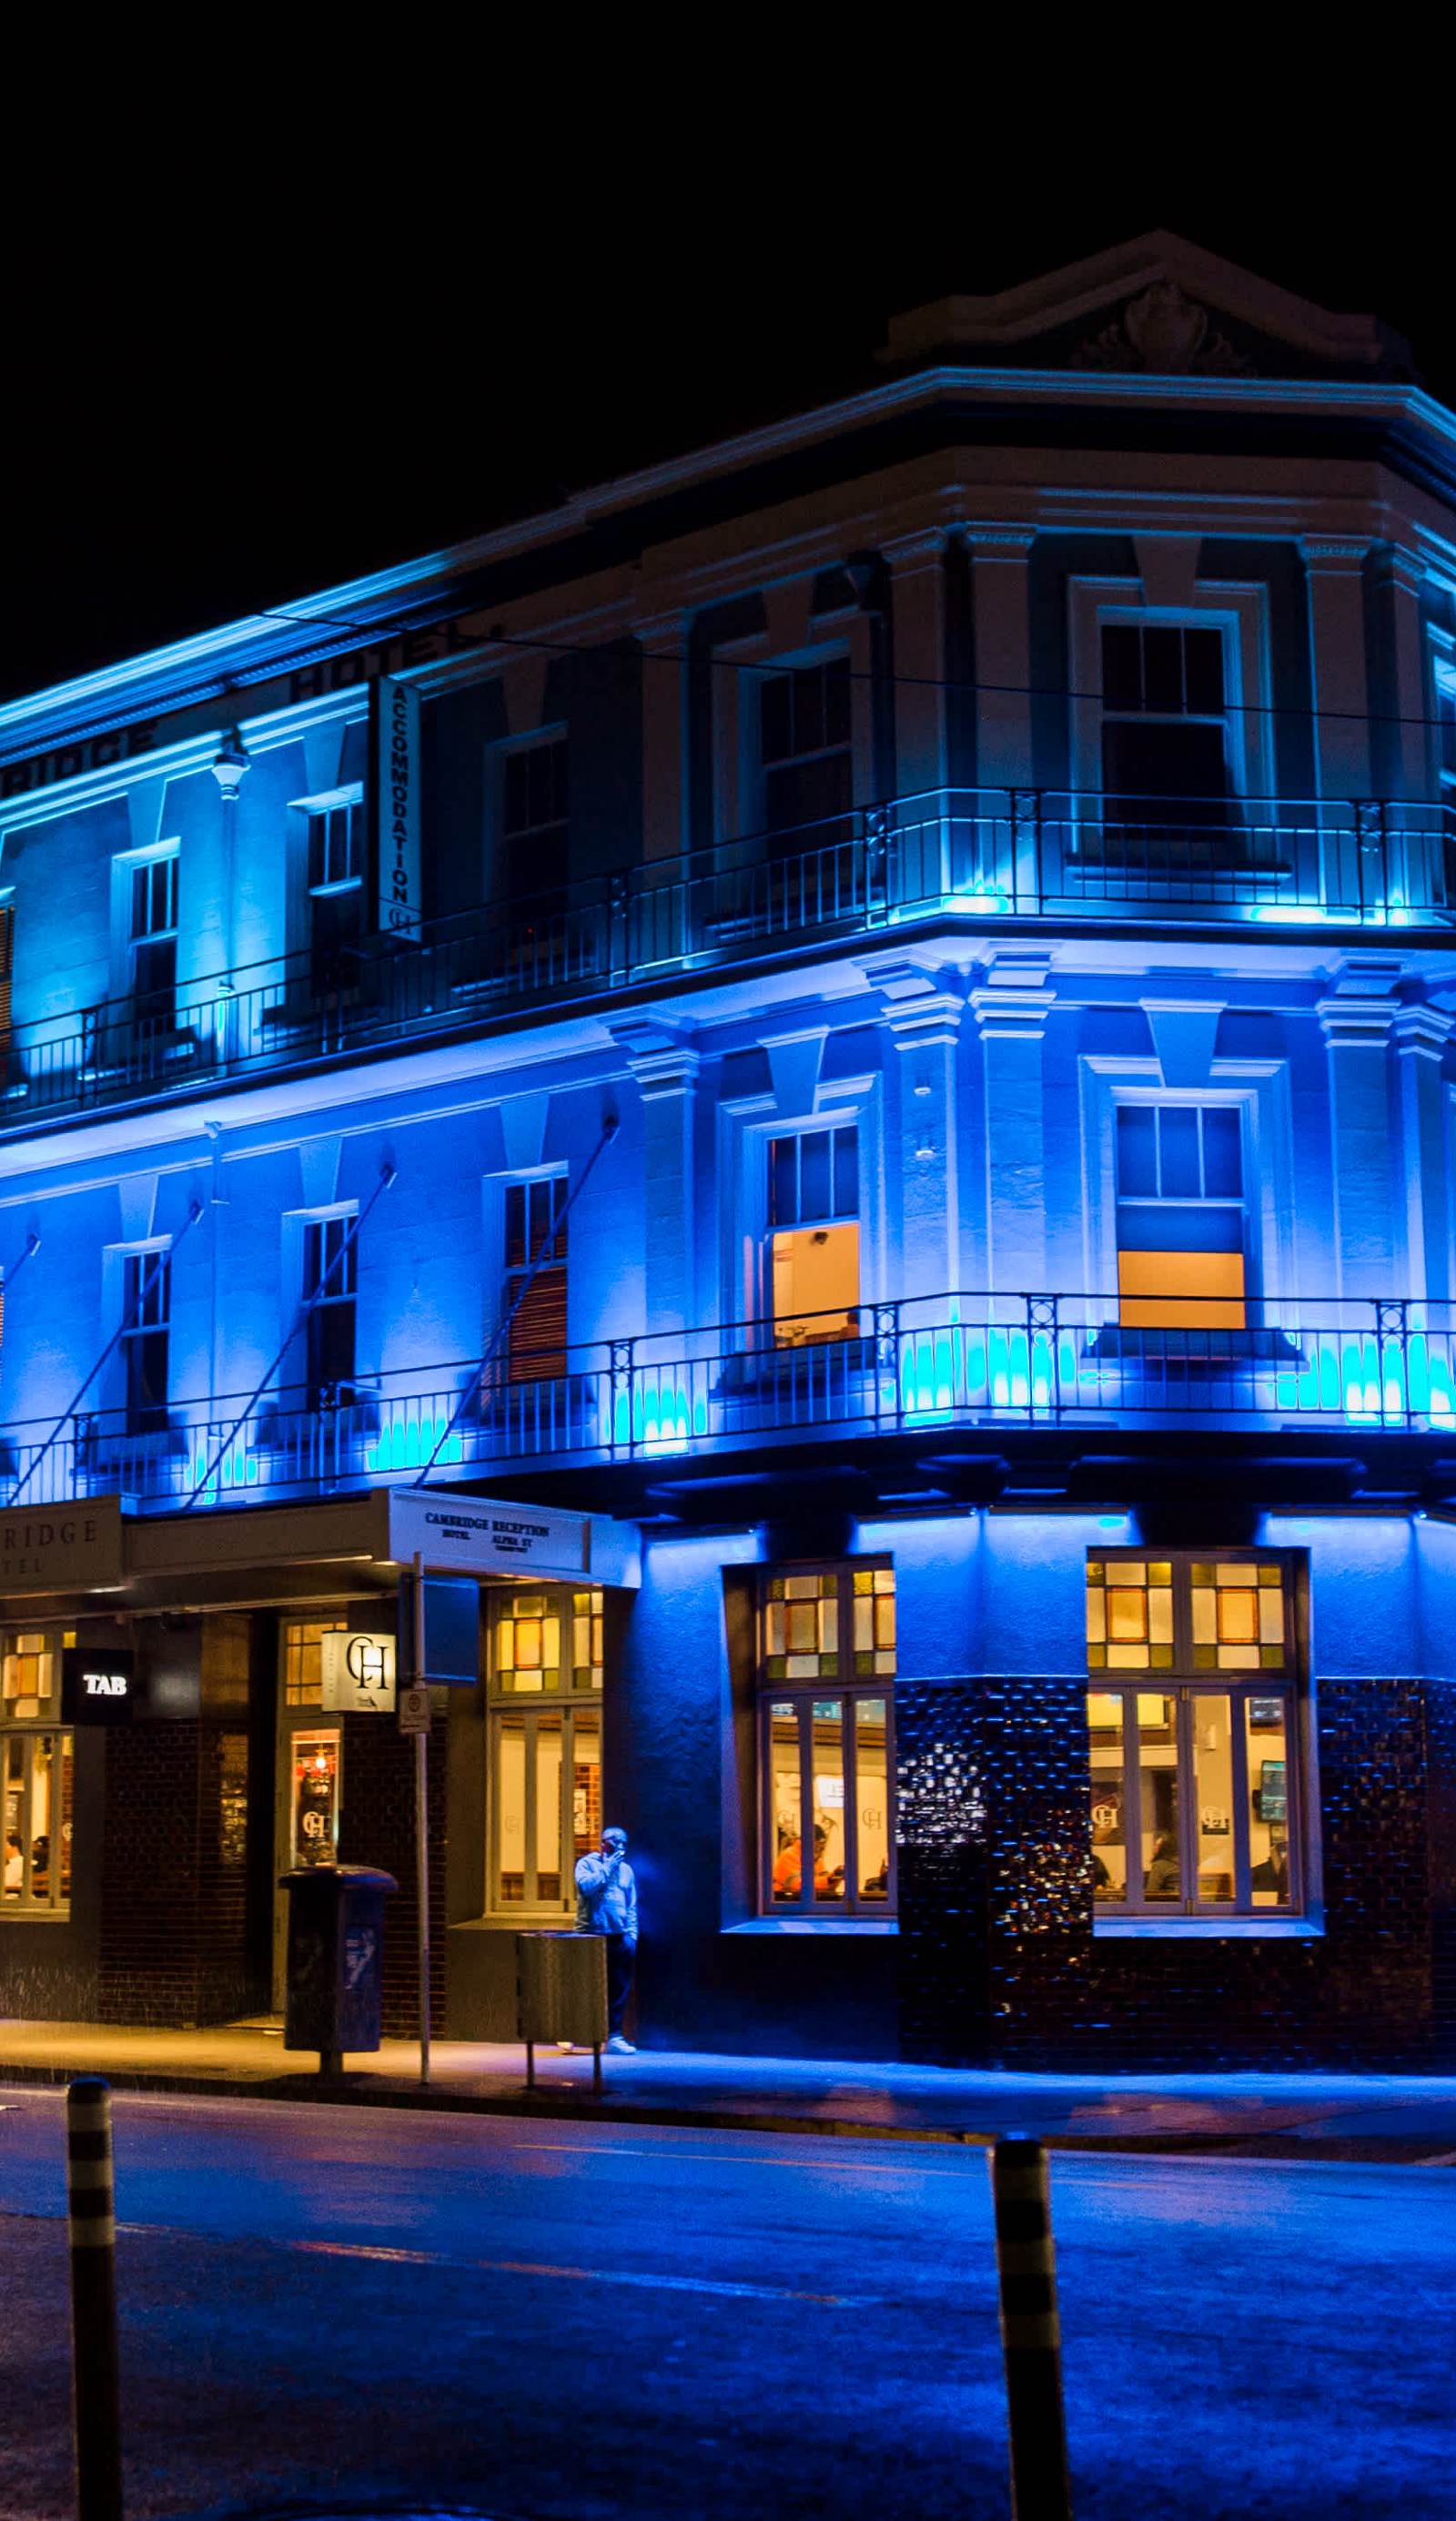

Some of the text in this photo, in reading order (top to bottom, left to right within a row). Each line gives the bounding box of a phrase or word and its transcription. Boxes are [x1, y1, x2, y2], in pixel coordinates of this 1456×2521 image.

[290, 623, 480, 704] HOTEL
[390, 686, 410, 904] ACCOMMODATION
[5, 1519, 96, 1550] RIDGE
[425, 1513, 549, 1536] CAMBRIDGE RECEPTION
[347, 1635, 389, 1690] CH
[83, 1675, 127, 1696] TAB
